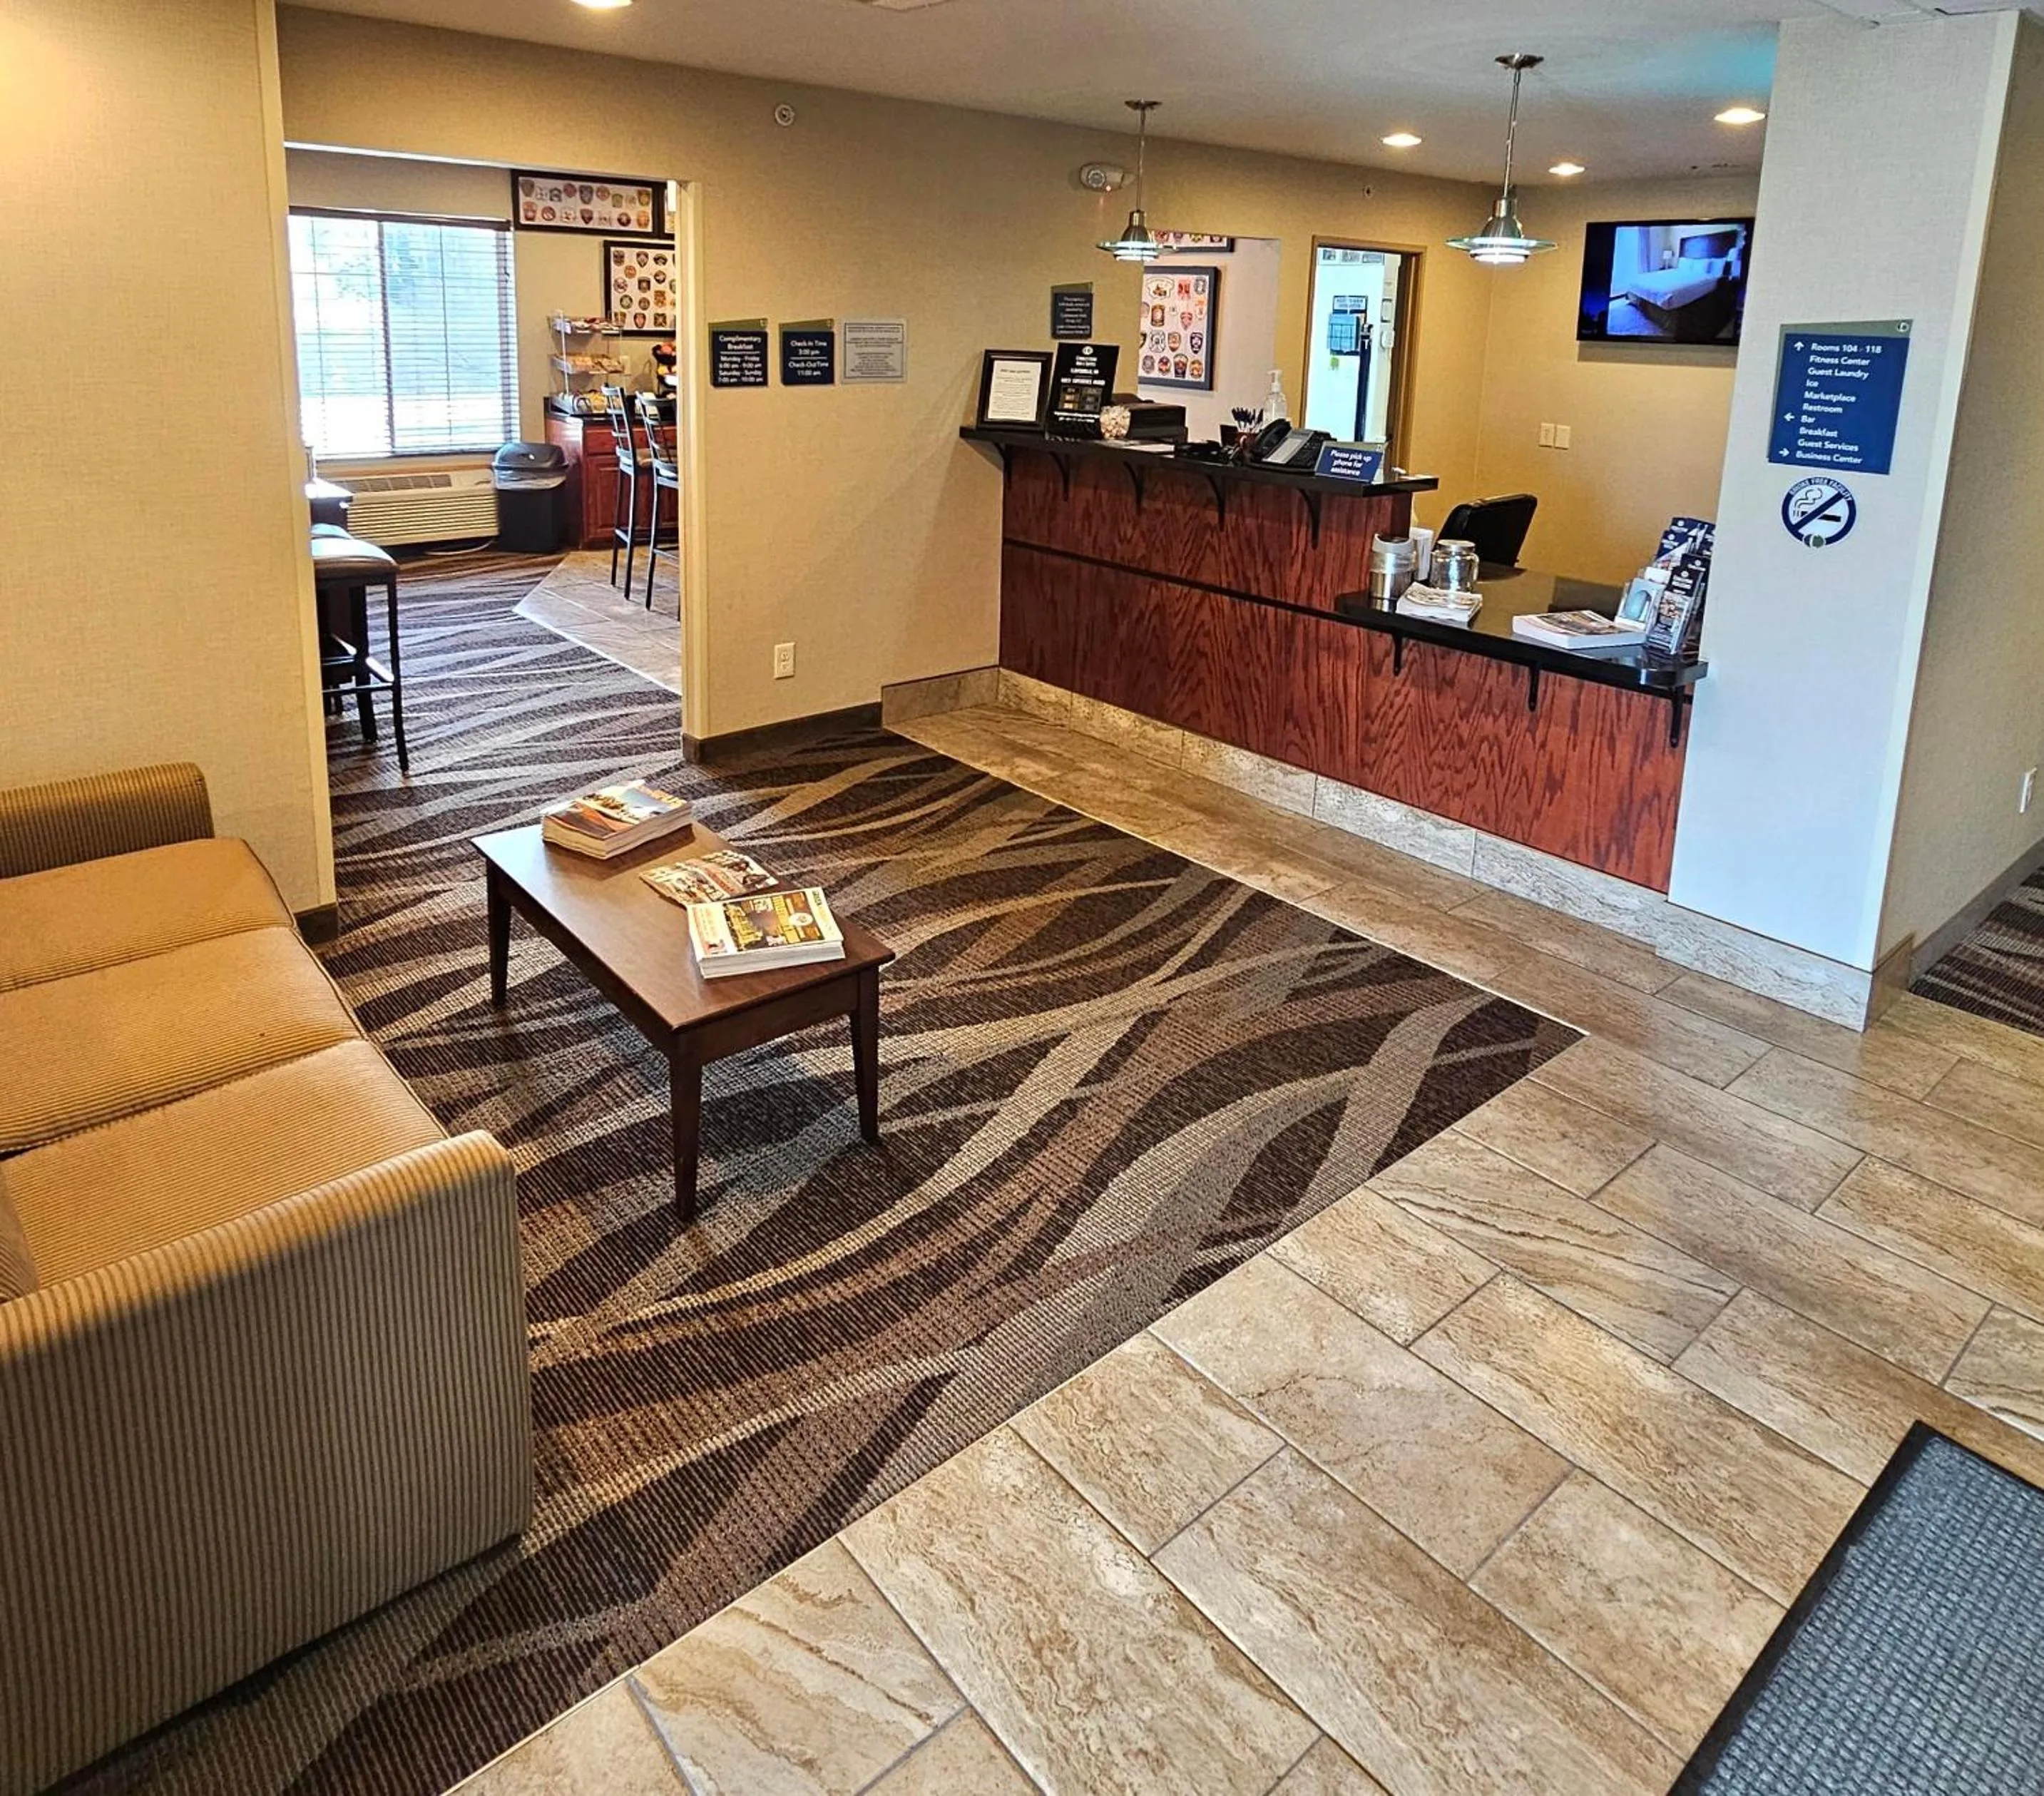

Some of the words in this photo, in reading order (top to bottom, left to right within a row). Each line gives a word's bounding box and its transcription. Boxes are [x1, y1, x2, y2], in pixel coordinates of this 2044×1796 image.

[719, 335, 762, 343] Complimentary
[1812, 343, 1840, 352] Rooms
[1842, 344, 1859, 352] 104
[1809, 355, 1839, 364] Fitness
[1841, 357, 1870, 365] Center
[1807, 367, 1833, 376] Guest
[1835, 369, 1869, 380] Laundry
[1806, 379, 1819, 387] Ice
[1804, 391, 1856, 402] Marketplace
[1802, 403, 1843, 413] Restroom
[1799, 427, 1838, 437] Breakfast
[1798, 439, 1823, 448] Guest
[1824, 441, 1859, 451] Services
[1330, 449, 1349, 459] Please
[1349, 452, 1362, 461] pick
[1796, 450, 1831, 461] Business
[1833, 454, 1863, 464] Center
[1330, 467, 1361, 476] assistance
